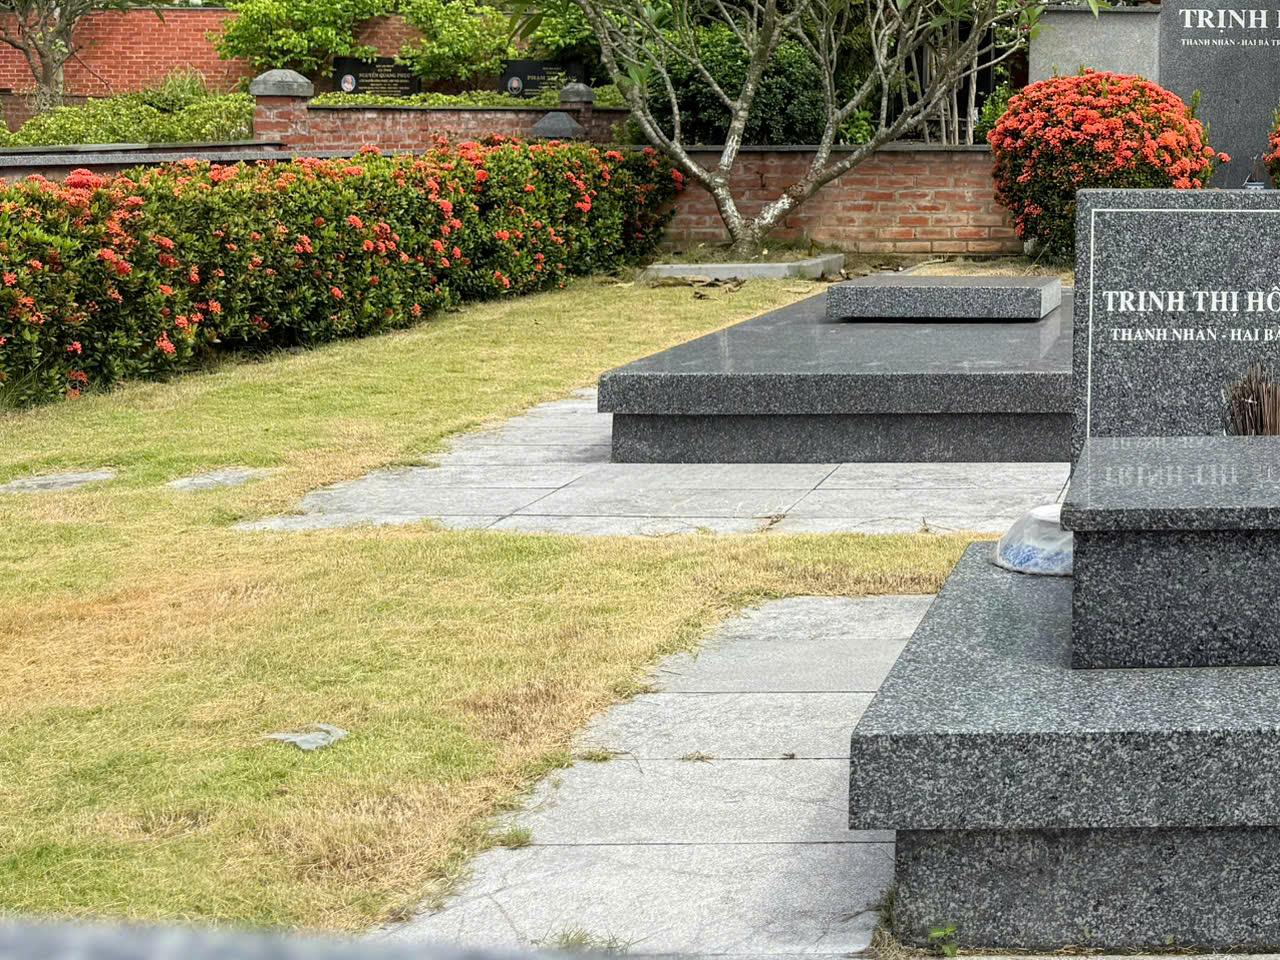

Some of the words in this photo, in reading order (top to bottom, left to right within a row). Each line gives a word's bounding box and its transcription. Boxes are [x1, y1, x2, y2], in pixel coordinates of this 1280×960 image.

[1178, 8, 1269, 33] TRỊNH
[1181, 38, 1211, 46] THANH
[1193, 290, 1239, 317] THỊ
[1111, 327, 1167, 341] THANH
[1231, 328, 1260, 341] HAI
